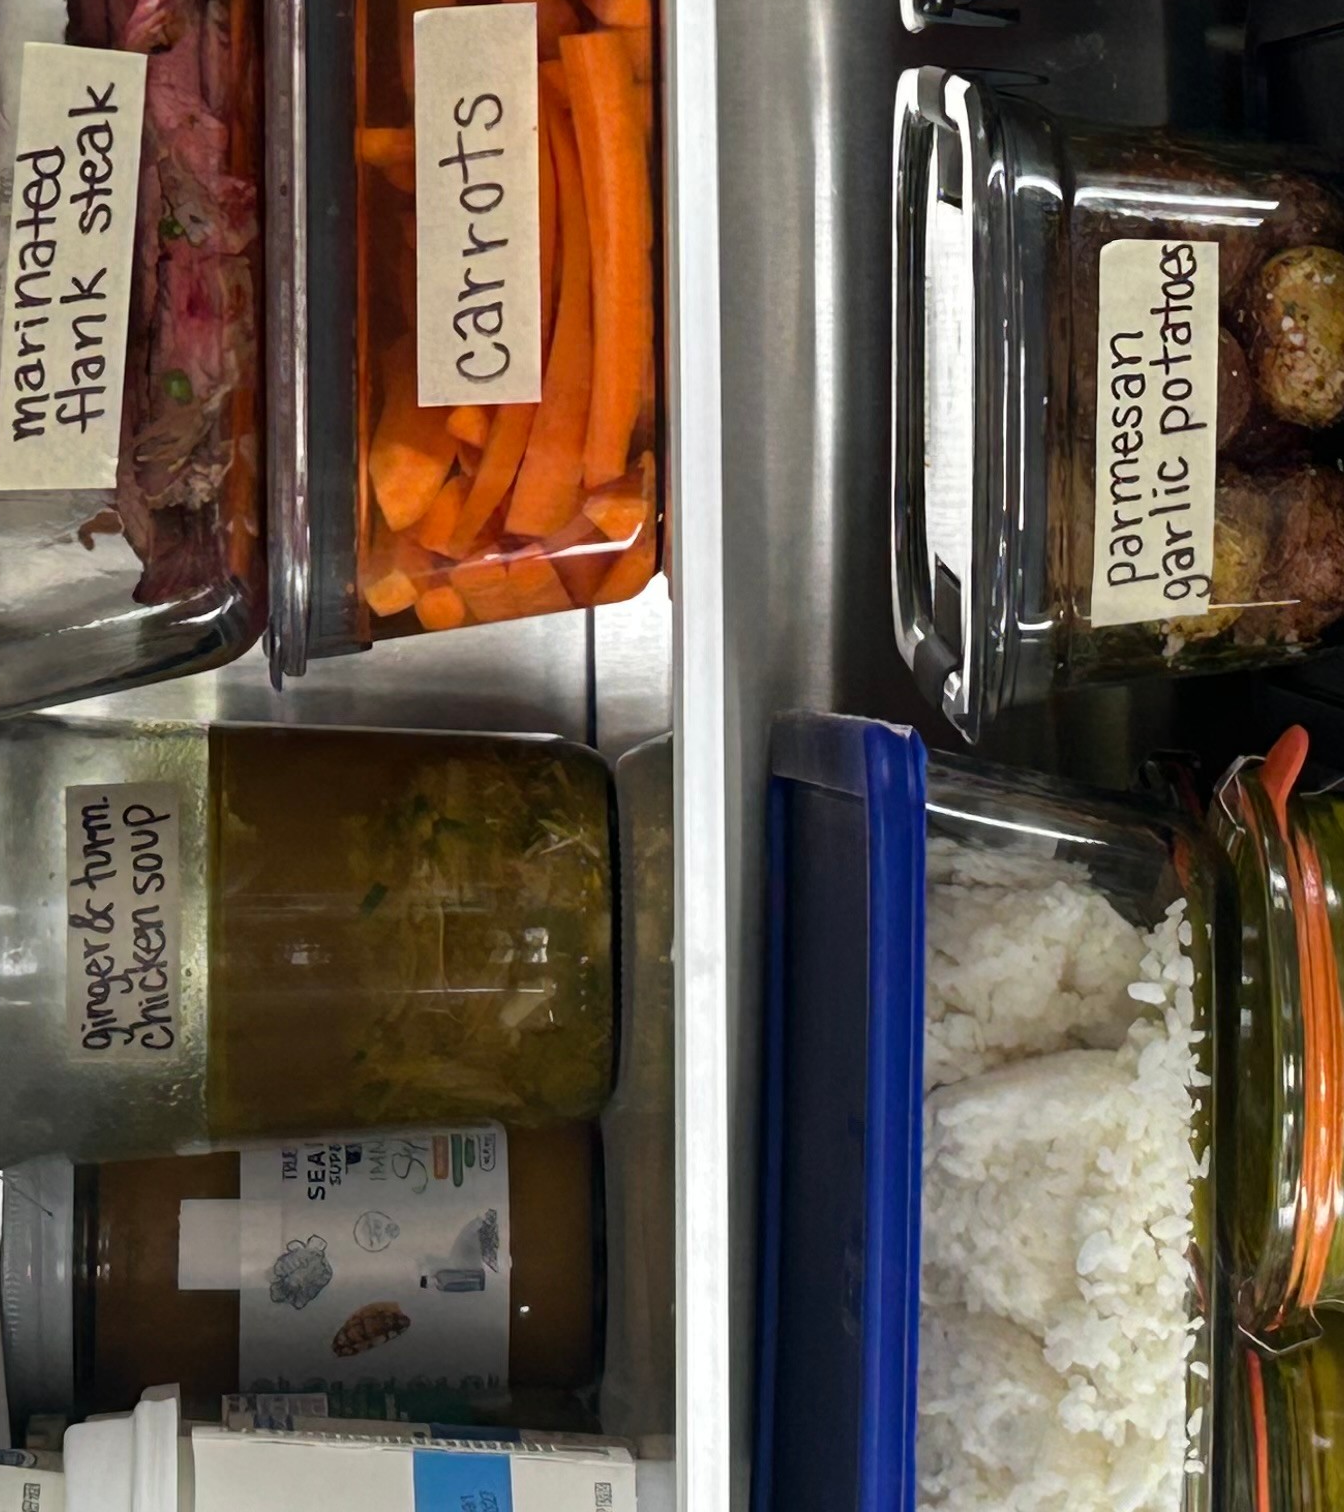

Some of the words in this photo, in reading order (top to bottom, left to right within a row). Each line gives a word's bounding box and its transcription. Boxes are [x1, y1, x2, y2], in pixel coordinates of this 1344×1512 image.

[68, 81, 118, 235] steak
[10, 145, 65, 442] marinated
[437, 92, 512, 385] carrots
[54, 267, 109, 434] flank
[1148, 242, 1208, 436] potatoes
[1106, 330, 1159, 587] parmesan
[1148, 455, 1212, 600] garlic
[68, 898, 115, 934] &
[69, 795, 118, 890] turm.
[122, 803, 172, 896] soup
[79, 937, 135, 1051] ginger
[125, 904, 175, 1050] chicken
